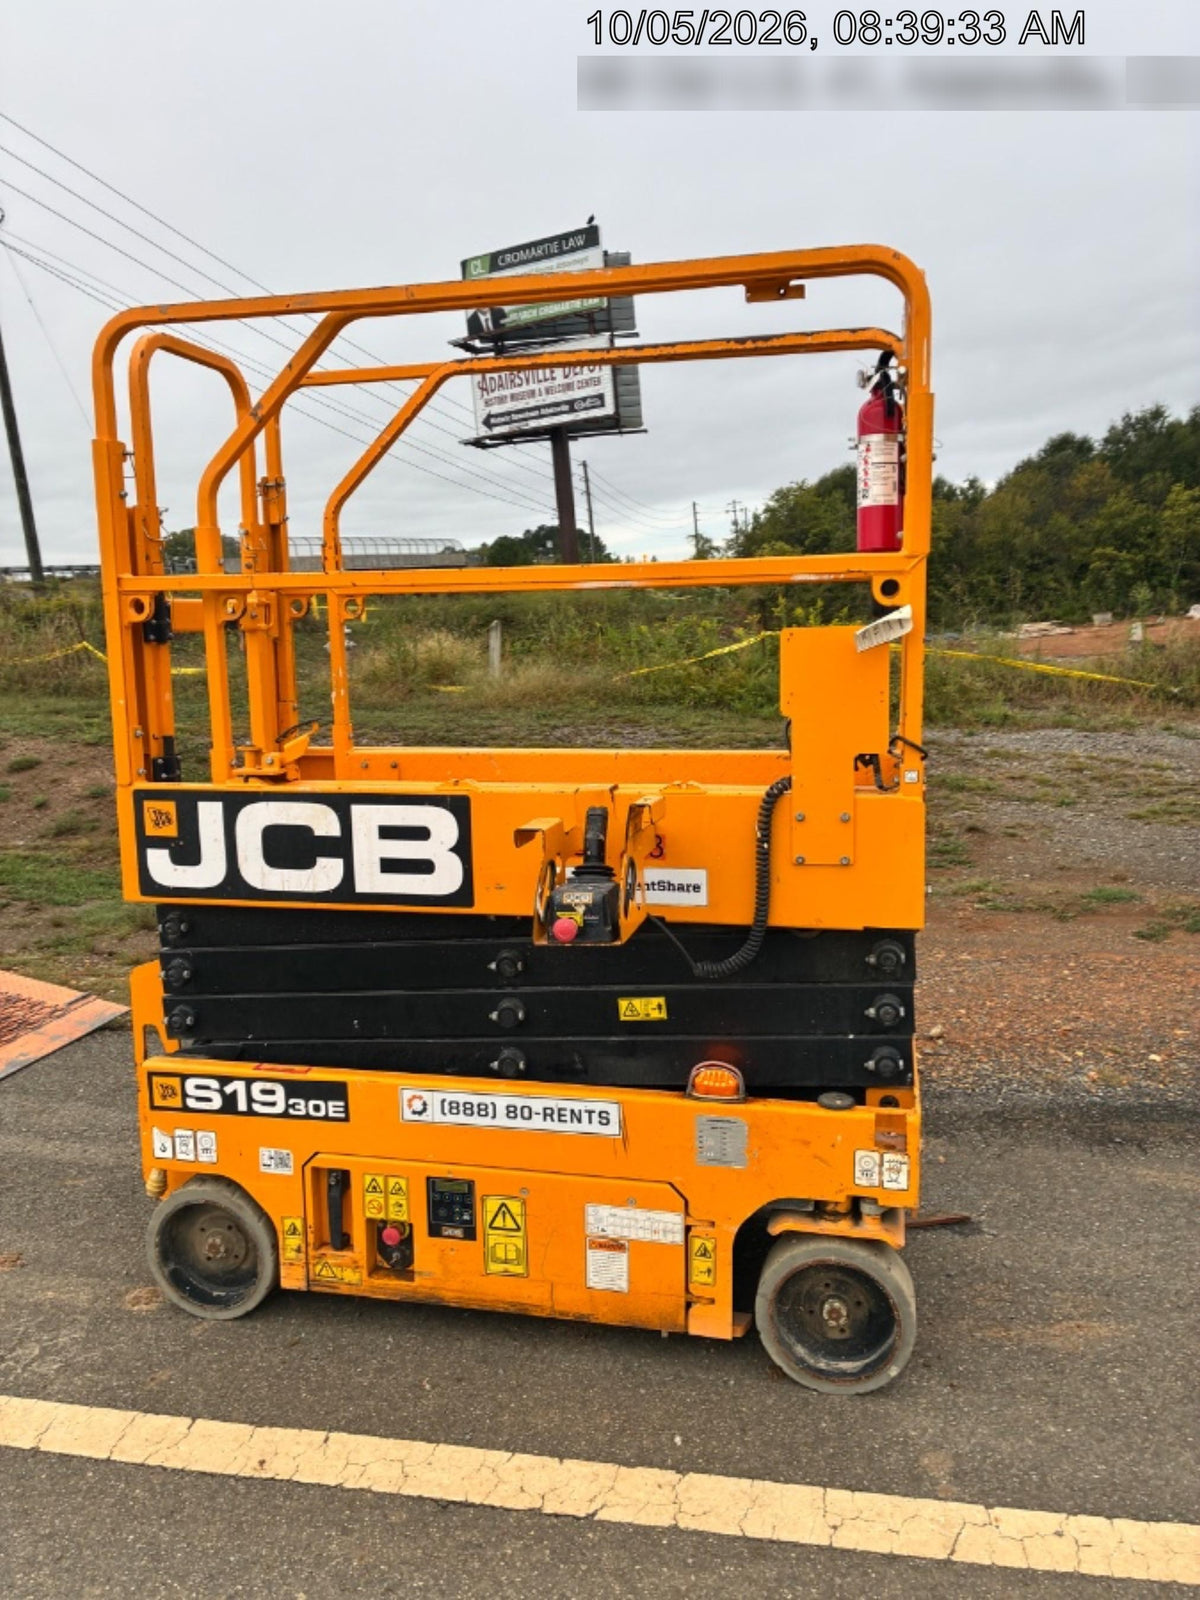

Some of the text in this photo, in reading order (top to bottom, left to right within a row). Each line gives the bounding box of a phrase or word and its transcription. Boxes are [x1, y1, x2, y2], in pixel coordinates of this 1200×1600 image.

[497, 234, 586, 266] CROMARTIE LAW
[470, 259, 486, 275] CL
[478, 367, 557, 399] ADAIRSVILLE
[545, 381, 575, 396] WELCOME
[577, 375, 601, 390] CENTER
[146, 801, 464, 896] JCB
[440, 1098, 611, 1126] (888) 80-RENTS
